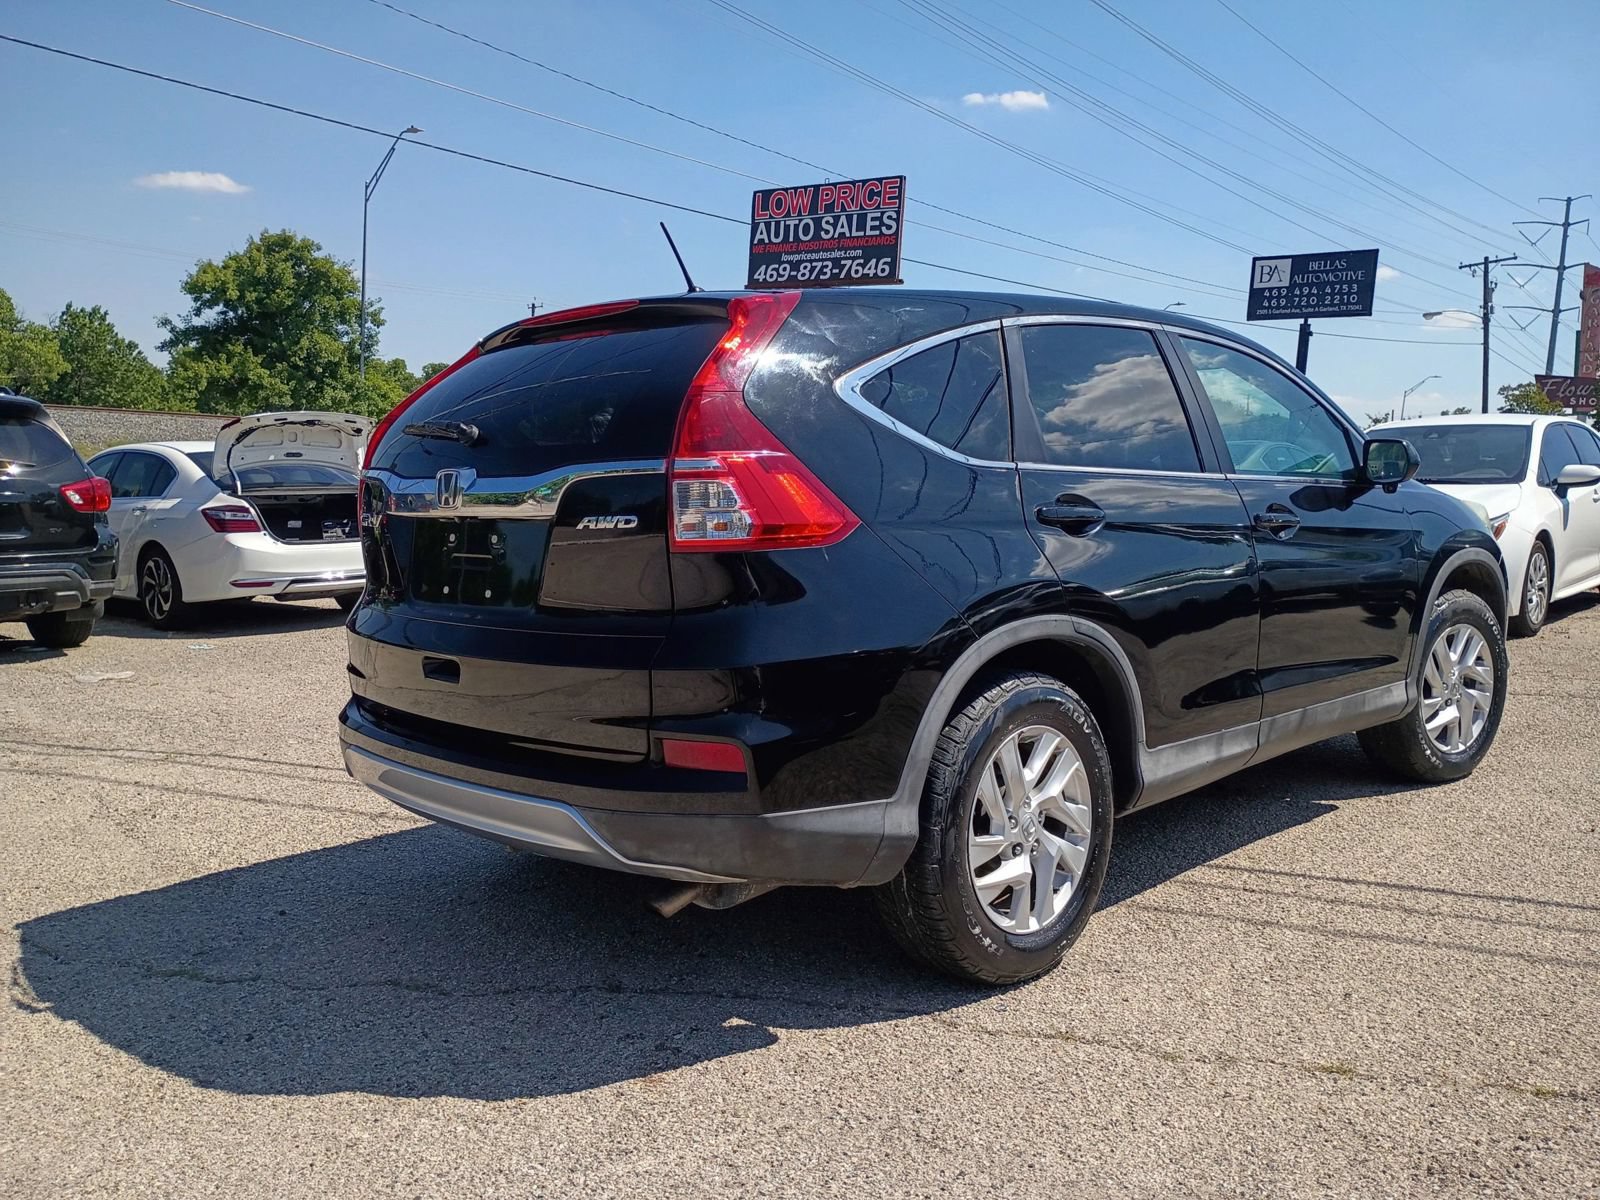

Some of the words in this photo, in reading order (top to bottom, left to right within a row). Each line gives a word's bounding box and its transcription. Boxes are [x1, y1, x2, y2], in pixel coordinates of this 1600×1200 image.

[755, 188, 813, 219] LOW
[818, 178, 900, 214] PRICE
[753, 218, 815, 244] AUTO
[820, 211, 898, 240] SALES
[752, 244, 763, 254] WE
[765, 242, 797, 253] FINANCE
[798, 239, 838, 251] NOSOTROS
[840, 235, 896, 248] FINANCIAMOS
[781, 248, 863, 263] lowpriceautosales.com
[753, 257, 891, 283] 469-873-7646
[1308, 258, 1347, 271] BELLAS
[1291, 270, 1366, 284] AUTOMOTIVE
[1263, 284, 1358, 297] 469.494.4753
[1262, 294, 1358, 307] 469.720.2210
[576, 515, 638, 530] AWD
